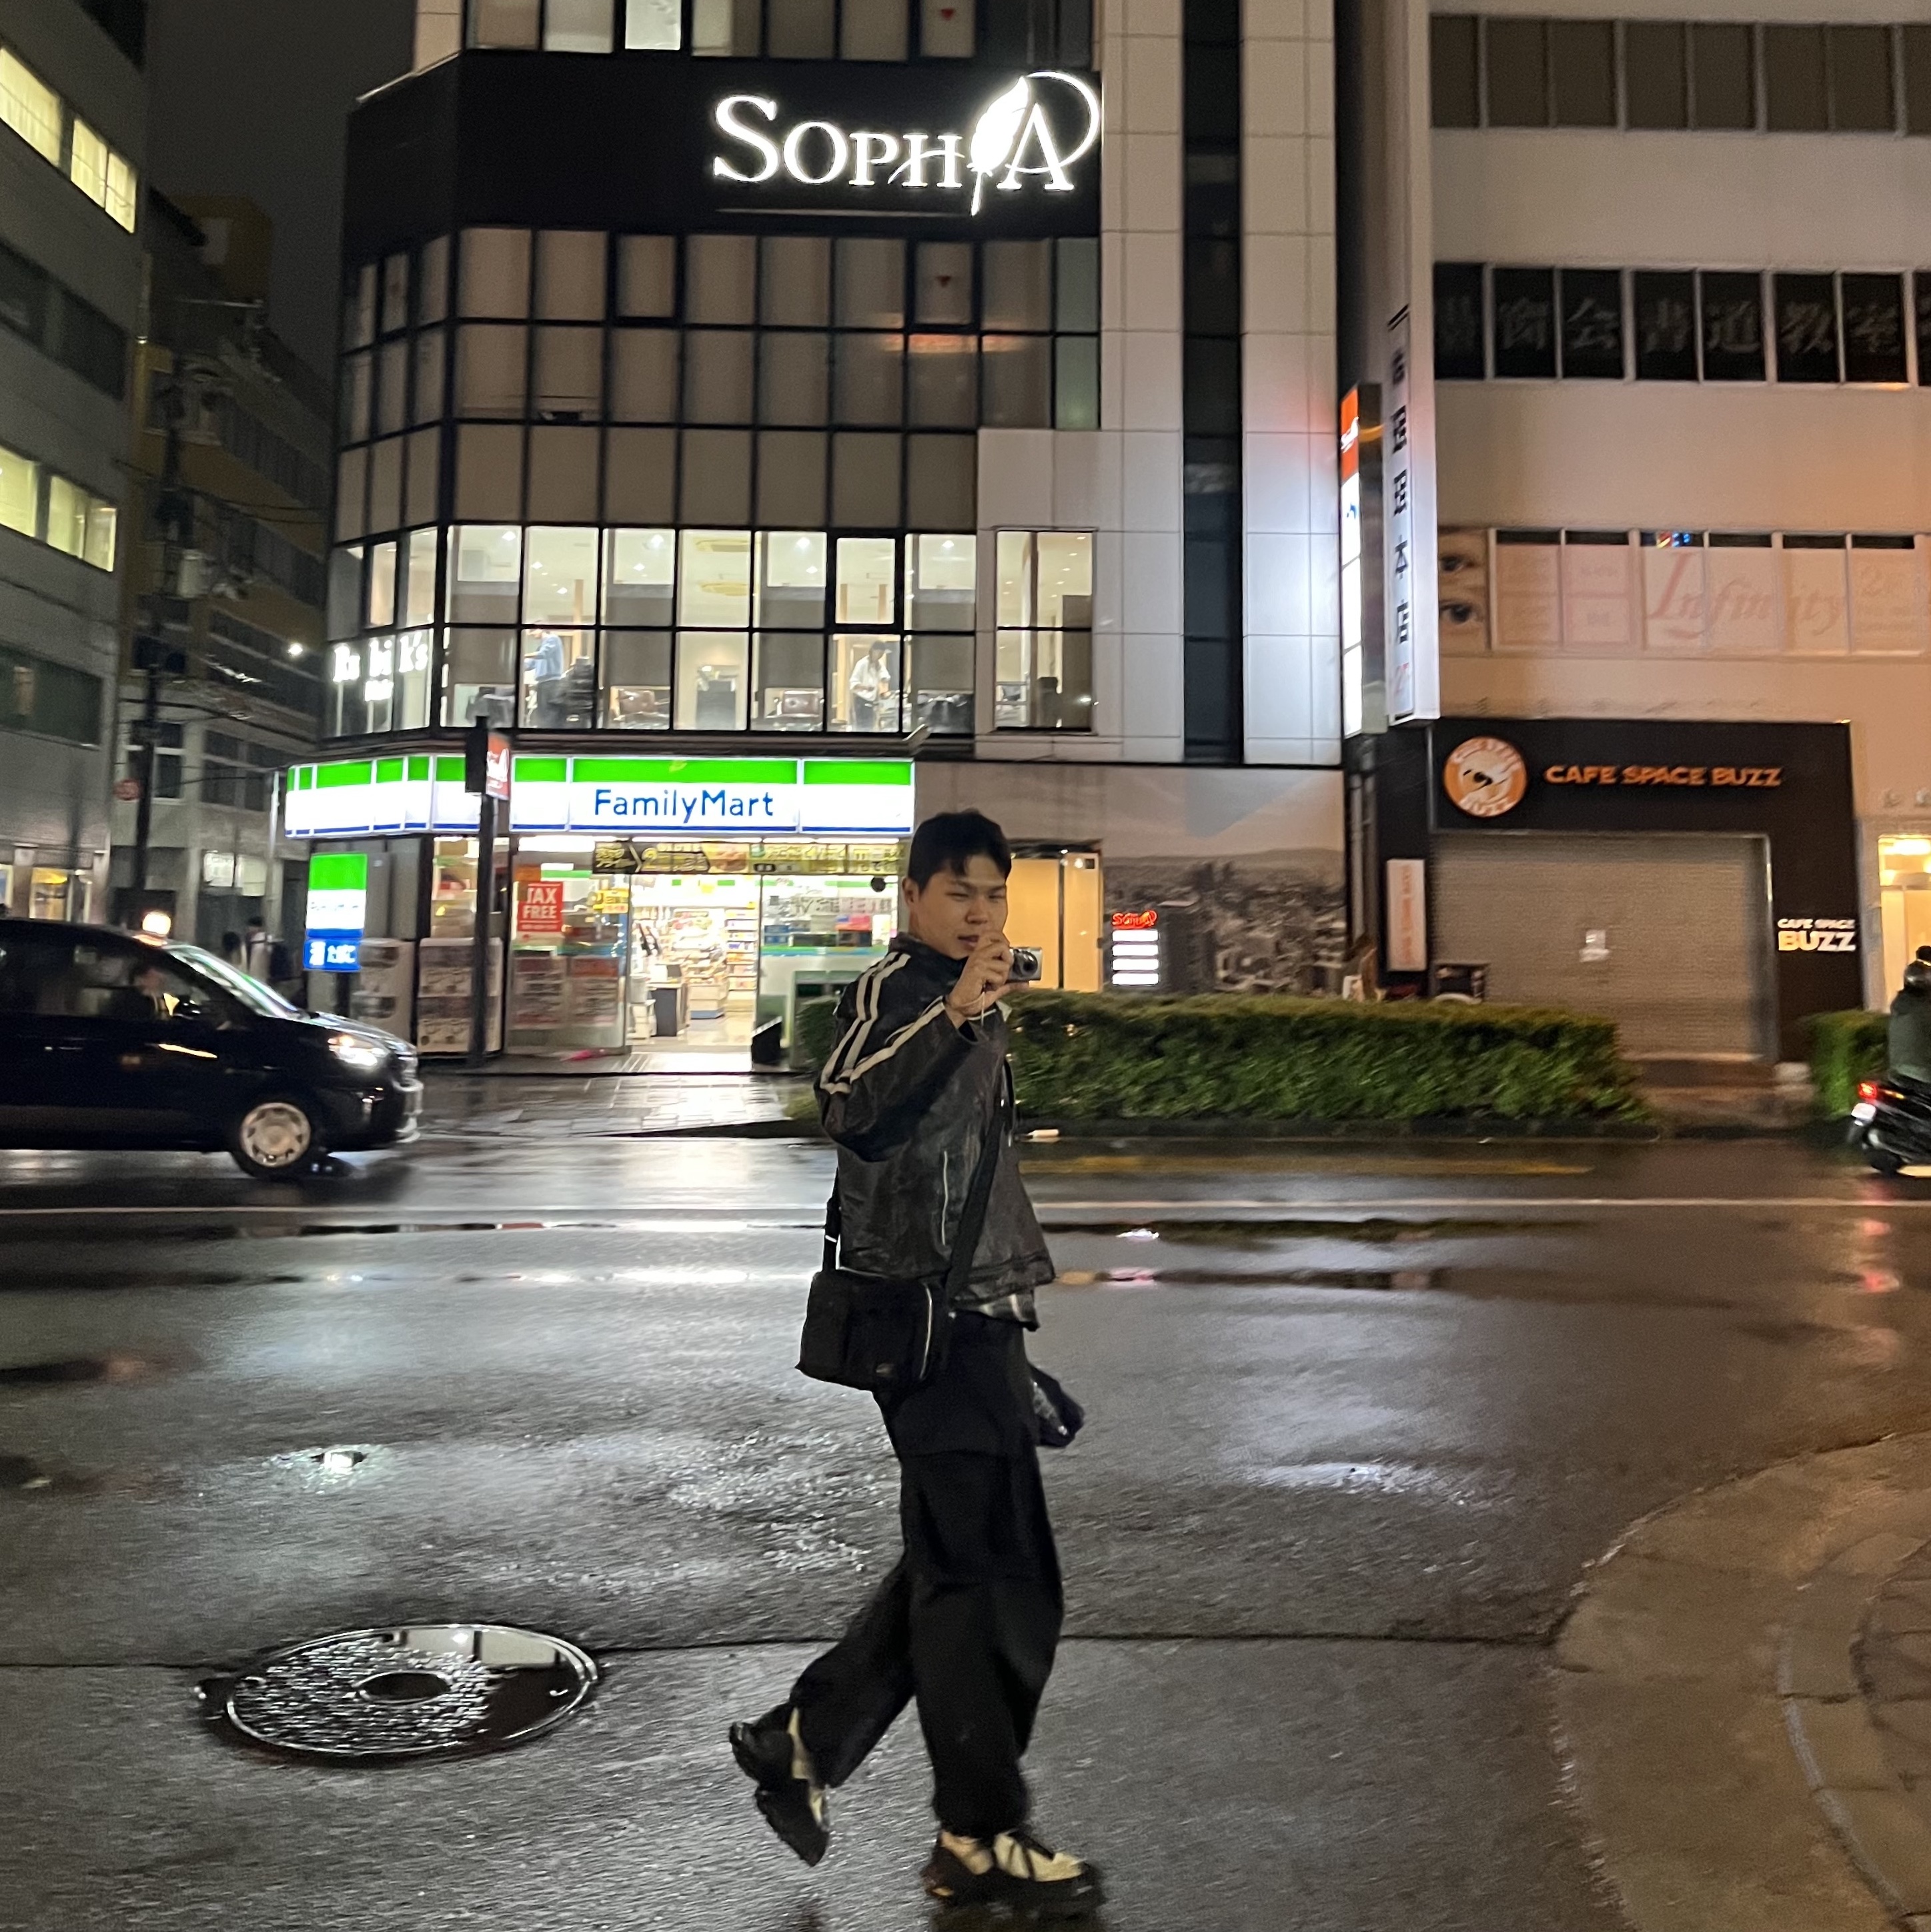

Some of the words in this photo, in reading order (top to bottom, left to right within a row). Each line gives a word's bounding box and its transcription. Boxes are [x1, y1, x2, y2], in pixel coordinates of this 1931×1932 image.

[1543, 765, 1617, 785] CAFE
[1621, 765, 1706, 786] SPACE
[1710, 767, 1782, 787] BUZZ
[594, 789, 774, 824] FamilyMart
[527, 888, 558, 904] TAX
[522, 905, 558, 920] FREE
[1777, 918, 1814, 929] CAFE
[1778, 930, 1856, 952] BUZZ
